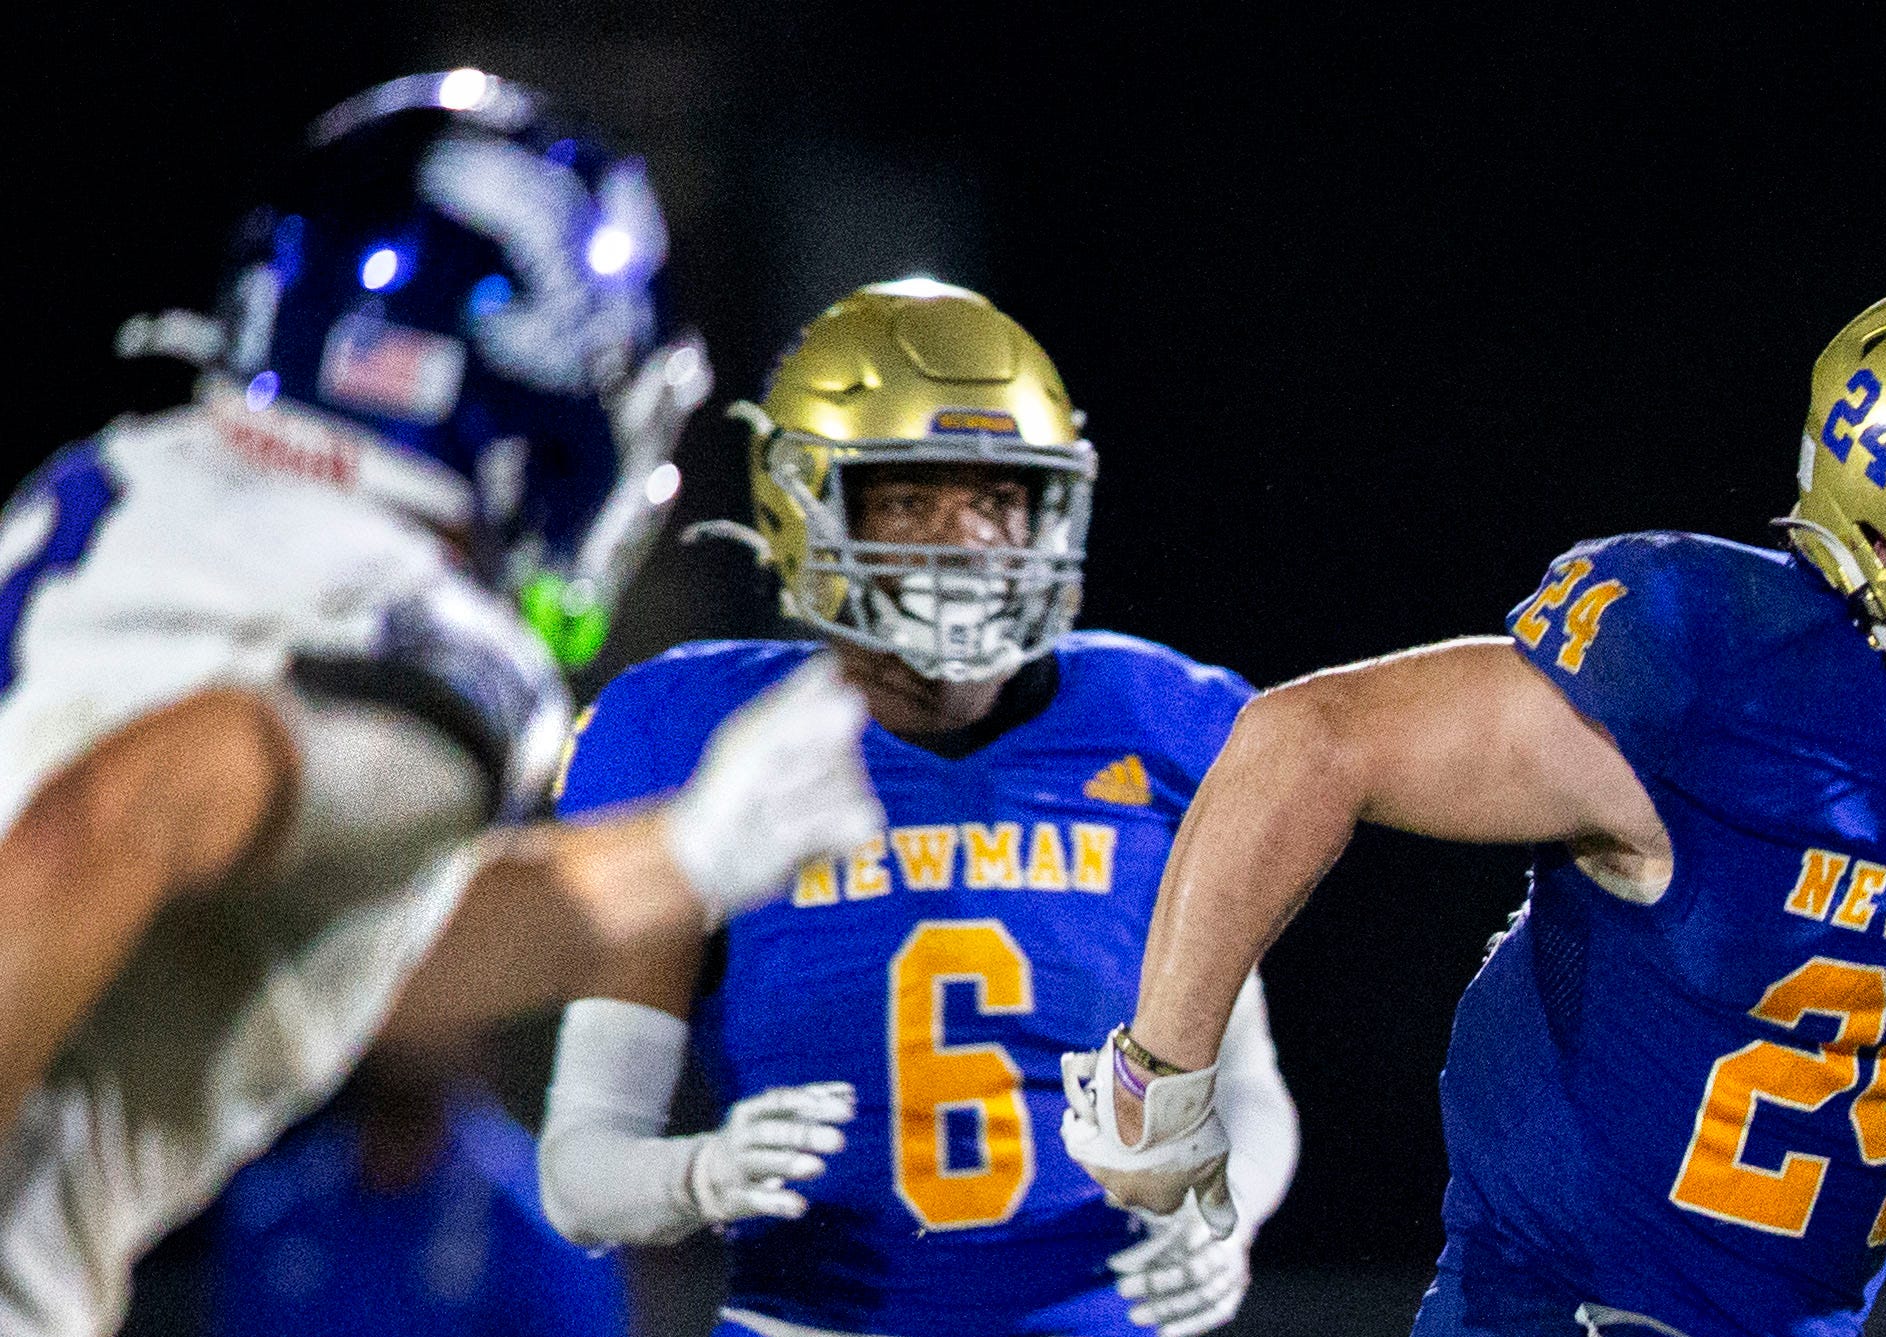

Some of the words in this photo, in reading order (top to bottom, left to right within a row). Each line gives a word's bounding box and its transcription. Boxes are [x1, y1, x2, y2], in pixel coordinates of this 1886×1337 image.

[1510, 556, 1629, 675] 24
[792, 822, 1117, 907] NEWMAN
[887, 917, 1036, 1235] 6
